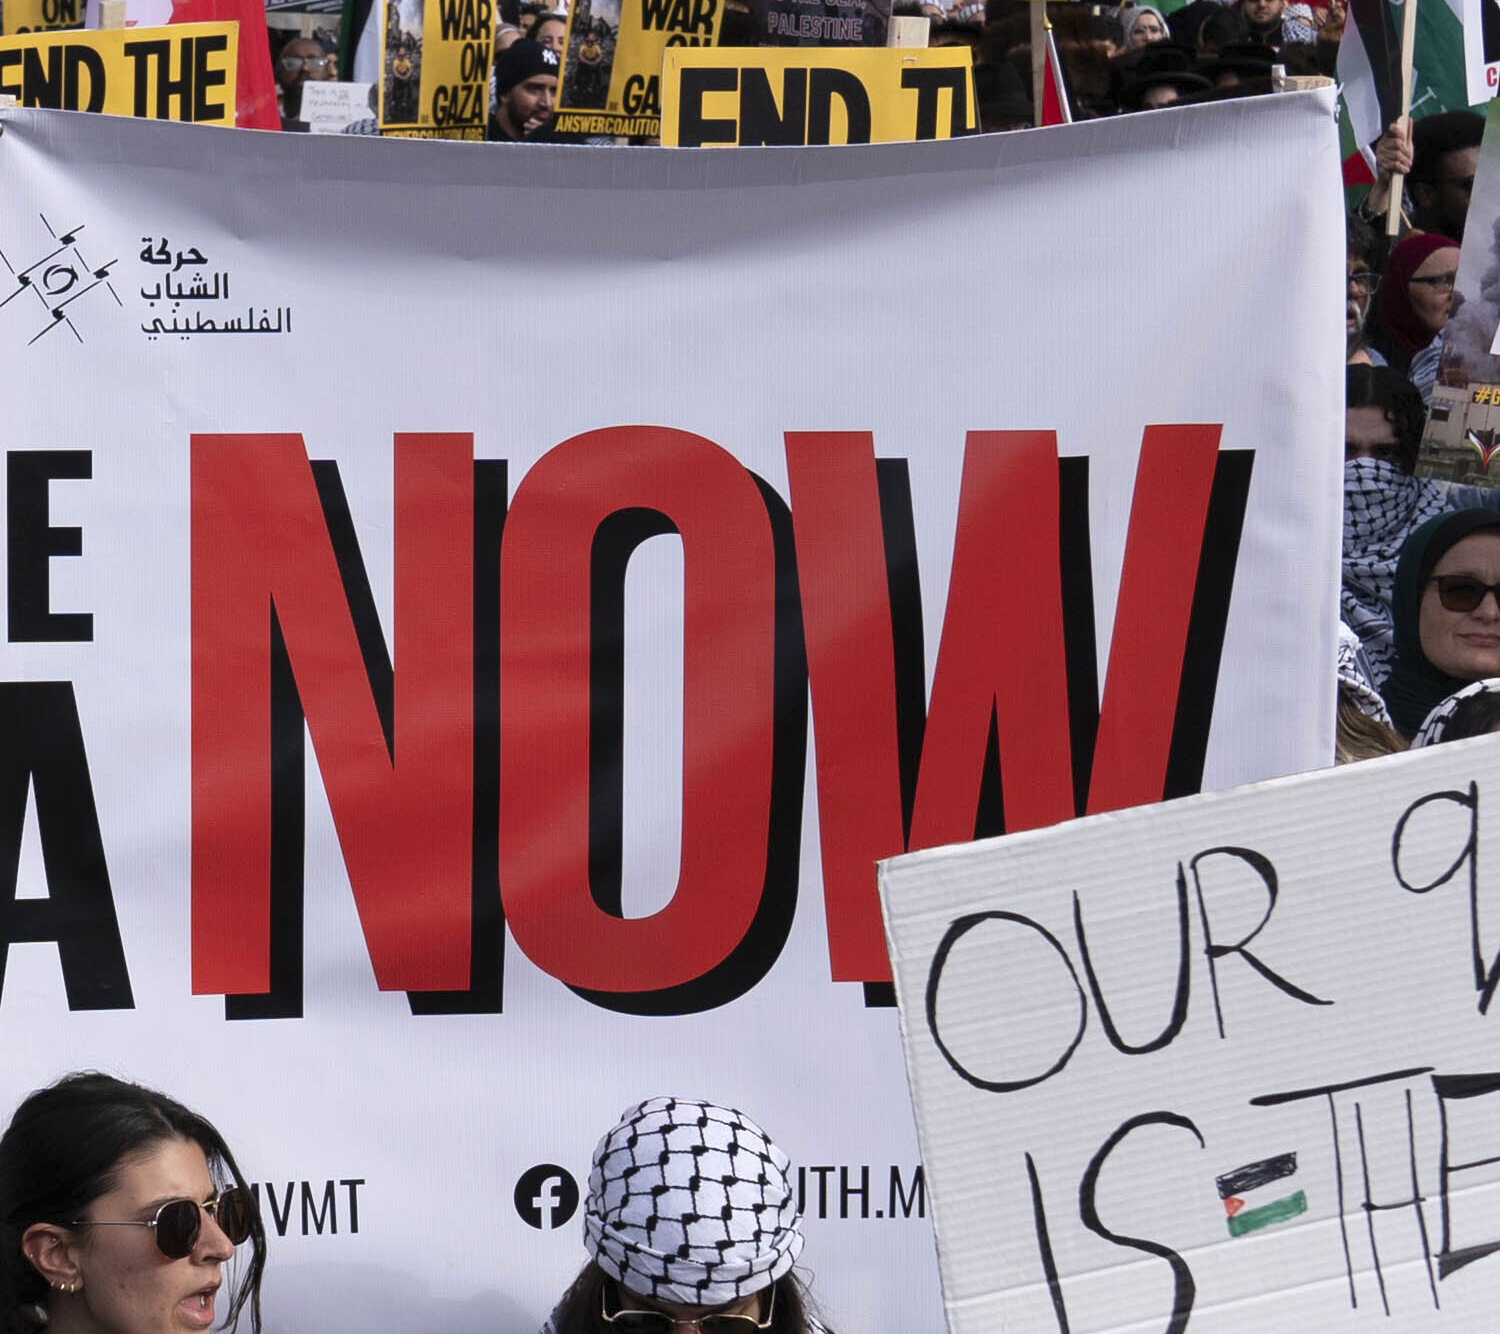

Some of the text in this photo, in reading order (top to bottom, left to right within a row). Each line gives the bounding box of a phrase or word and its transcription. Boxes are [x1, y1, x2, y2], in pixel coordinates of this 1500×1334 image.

[768, 11, 863, 41] PALESTINE
[140, 237, 208, 271] حركة
[141, 273, 229, 306] الشباب
[141, 307, 292, 340] الفلسطيني
[189, 423, 1251, 1016] NOW
[925, 845, 1333, 1091] OUR
